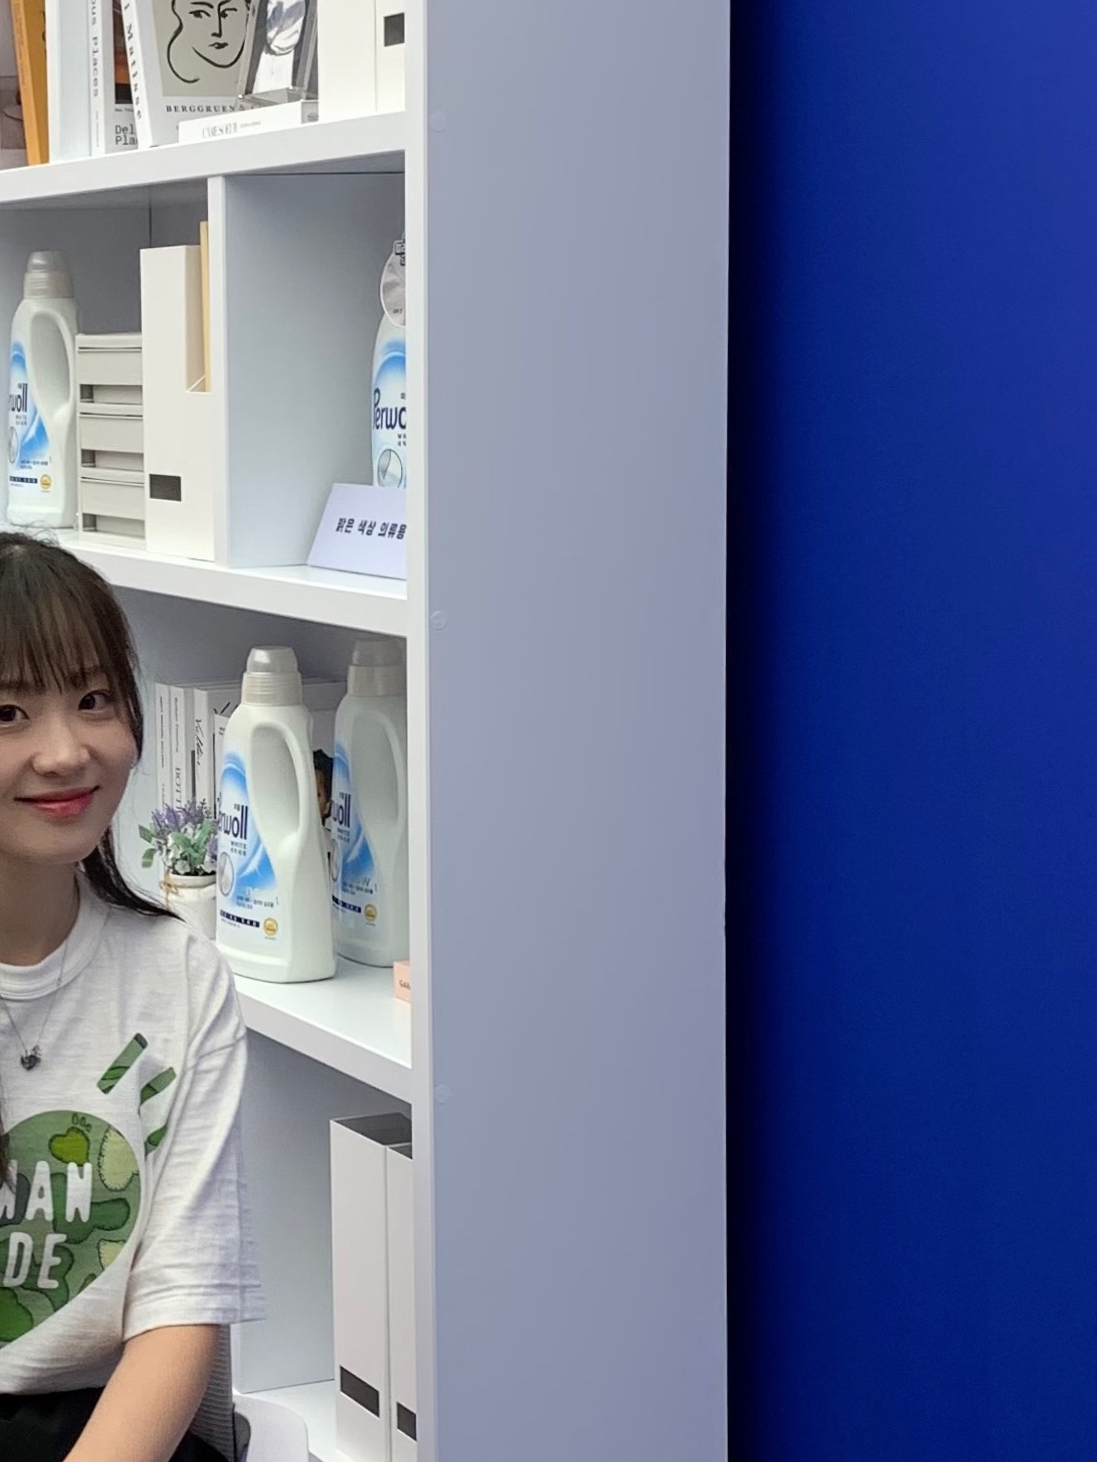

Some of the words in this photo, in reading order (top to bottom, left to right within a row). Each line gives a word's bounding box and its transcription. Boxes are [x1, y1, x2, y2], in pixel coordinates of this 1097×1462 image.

[92, 36, 100, 97] Places
[126, 22, 142, 120] Matisse
[166, 104, 236, 113] BERGGRUEN
[115, 124, 135, 135] Del
[335, 517, 355, 534] 밝은
[357, 519, 377, 536] 색상
[378, 522, 407, 540] 의류용
